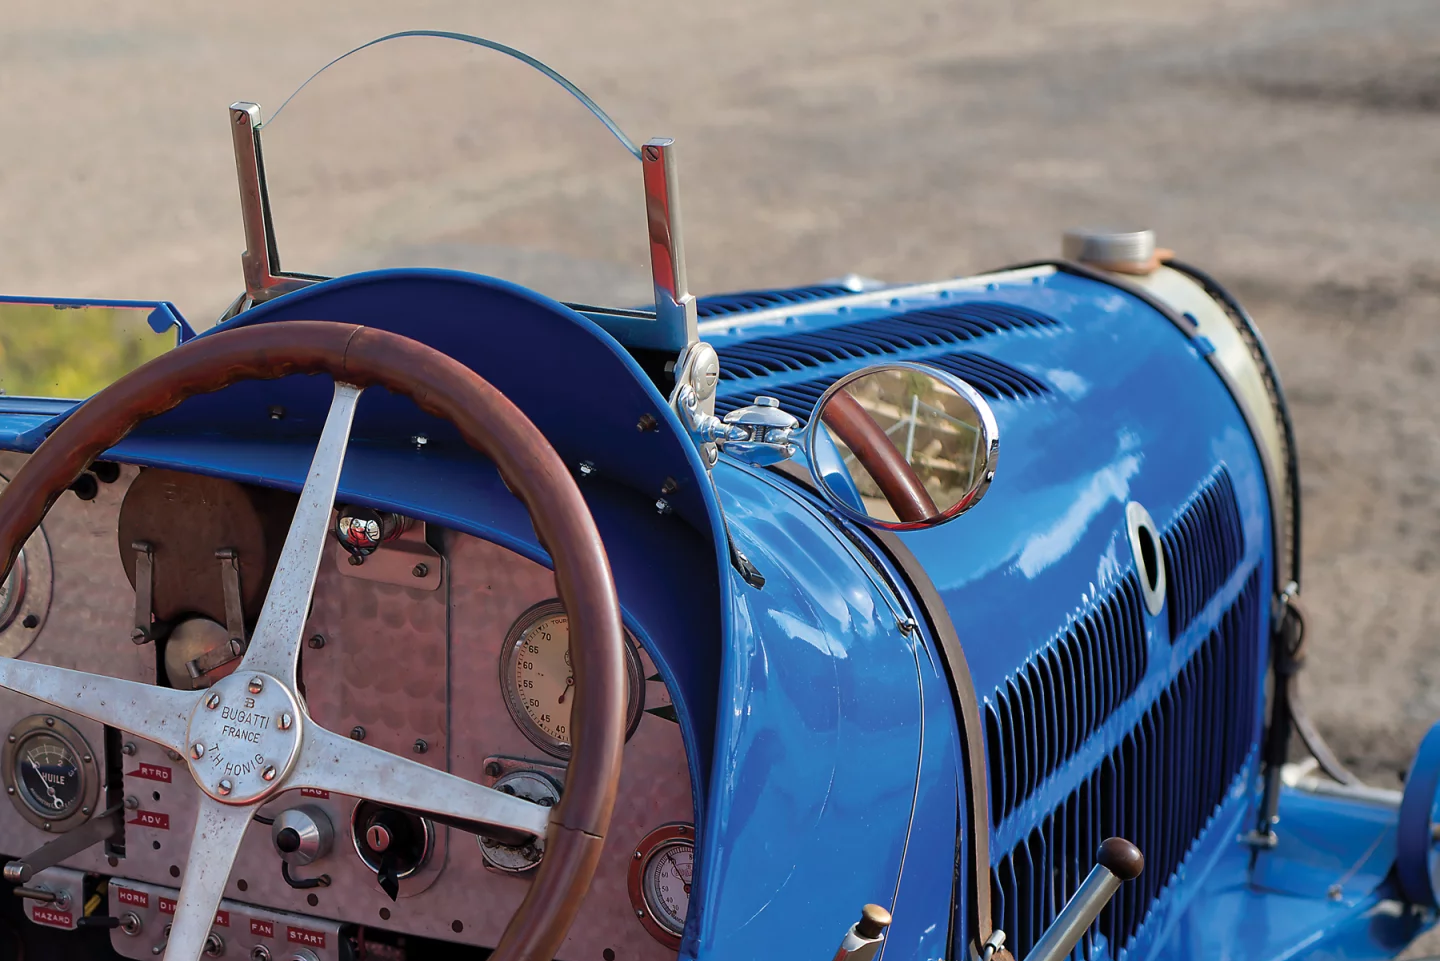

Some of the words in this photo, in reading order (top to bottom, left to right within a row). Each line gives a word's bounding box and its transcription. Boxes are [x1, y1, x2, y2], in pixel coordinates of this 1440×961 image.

[541, 632, 551, 641] 70
[528, 645, 539, 654] 65
[523, 661, 533, 670] 60
[523, 680, 533, 688] 55
[529, 699, 539, 707] 50
[221, 706, 270, 729] BUGATTI
[540, 714, 551, 723] 45
[222, 725, 261, 744] FRANCE
[555, 725, 566, 733] 40
[224, 753, 264, 776] HONIG
[42, 772, 65, 785] HUILE
[141, 767, 168, 779] RTRD
[142, 814, 168, 826] ADV.
[120, 891, 146, 904] HORN
[35, 911, 70, 924] HAZARD
[251, 923, 272, 934] FAN
[289, 930, 324, 944] START
